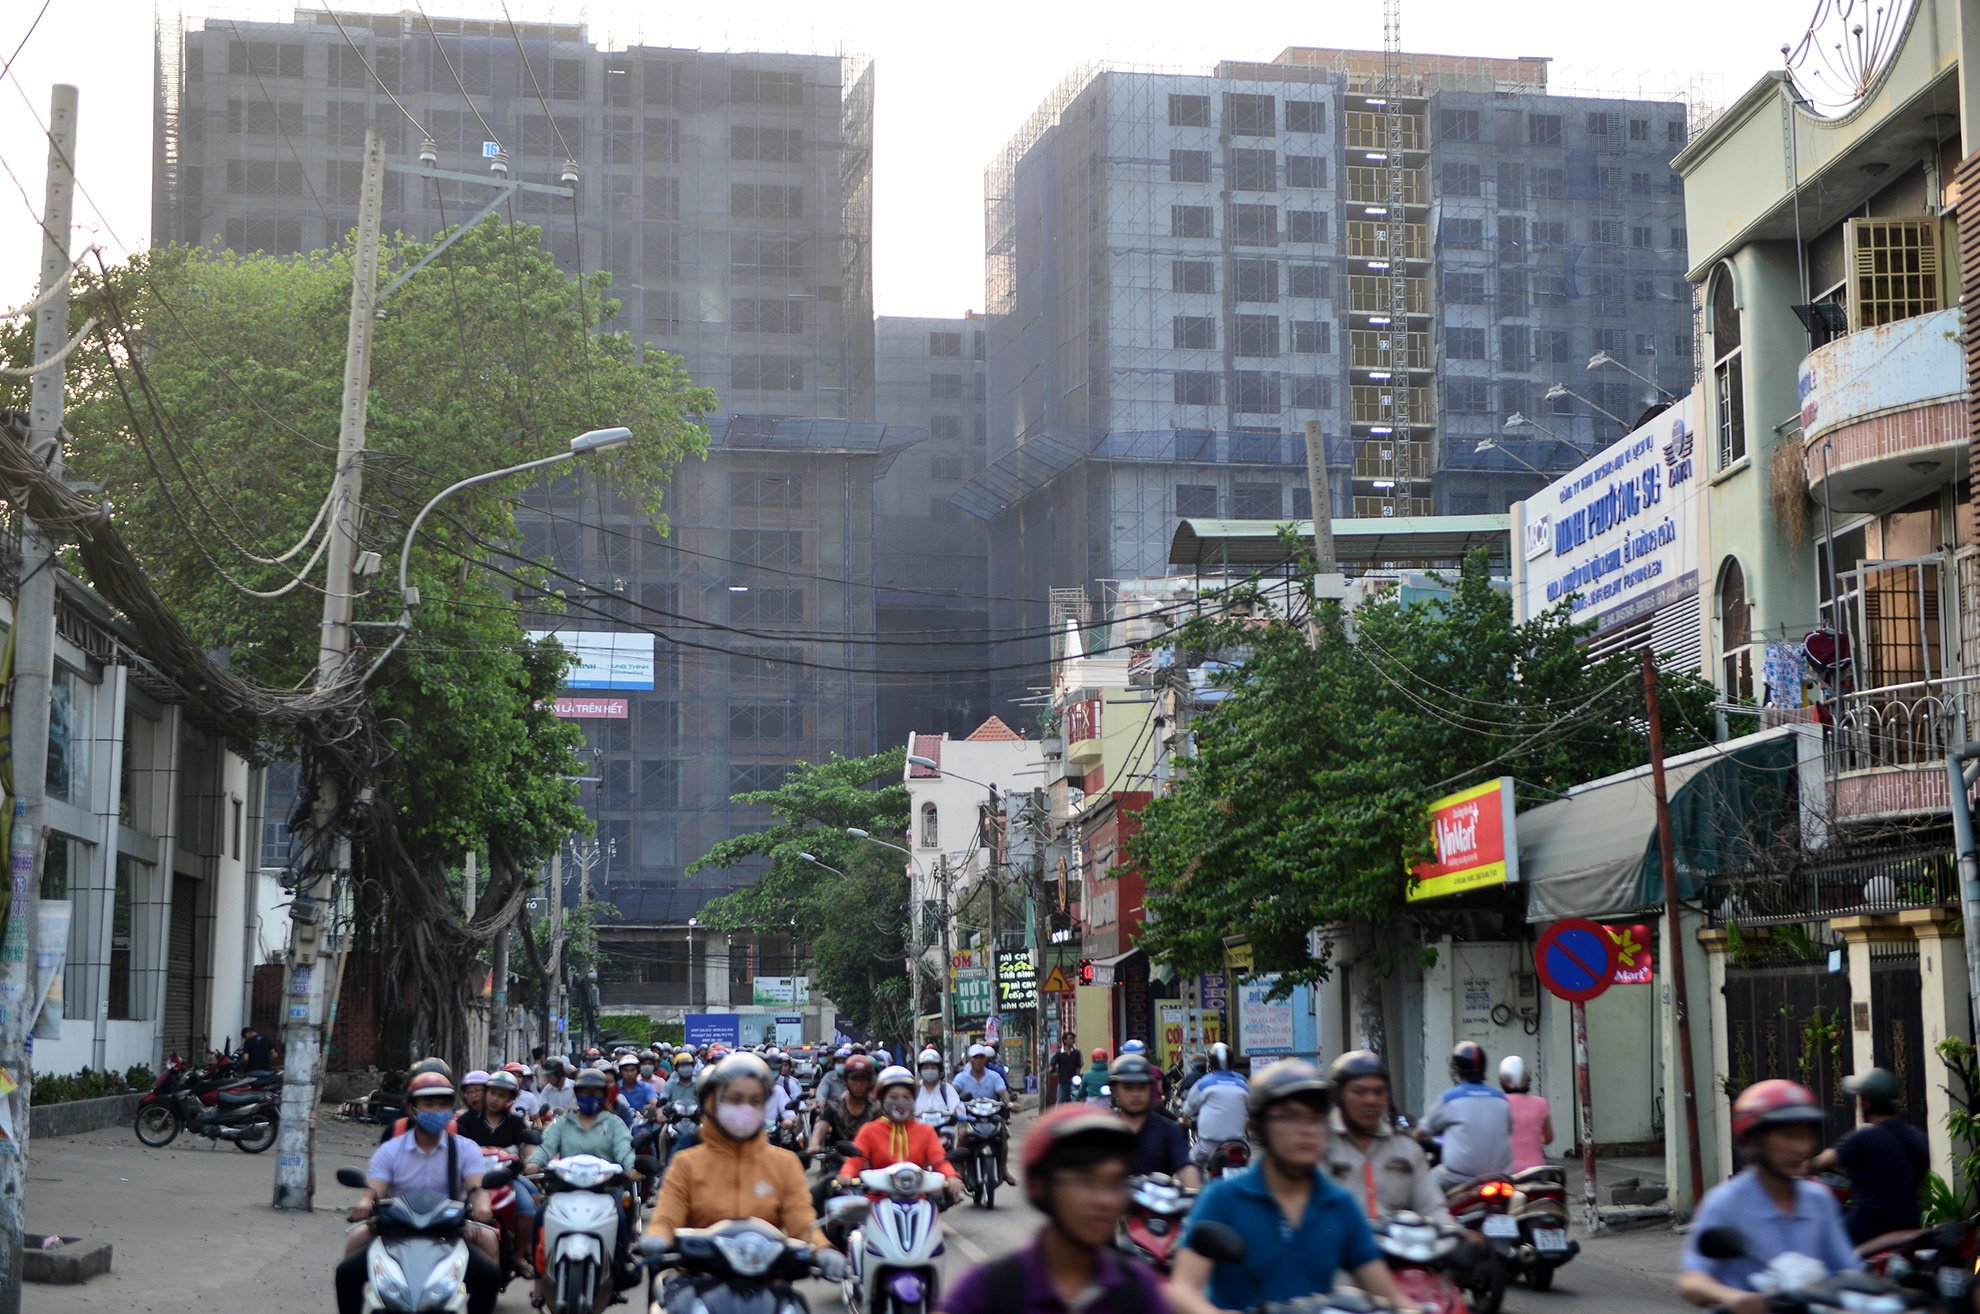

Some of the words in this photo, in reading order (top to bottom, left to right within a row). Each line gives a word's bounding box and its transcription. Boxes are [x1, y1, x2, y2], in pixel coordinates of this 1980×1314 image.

[485, 143, 498, 157] 16
[1642, 462, 1661, 509] SG
[576, 703, 602, 713] TRÊN
[604, 702, 624, 714] HẾT
[960, 979, 990, 997] HỚT
[1000, 982, 1010, 1000] 7
[1021, 981, 1036, 989] CAY
[961, 997, 990, 1014] TÓC
[1002, 1001, 1017, 1010] HÀN
